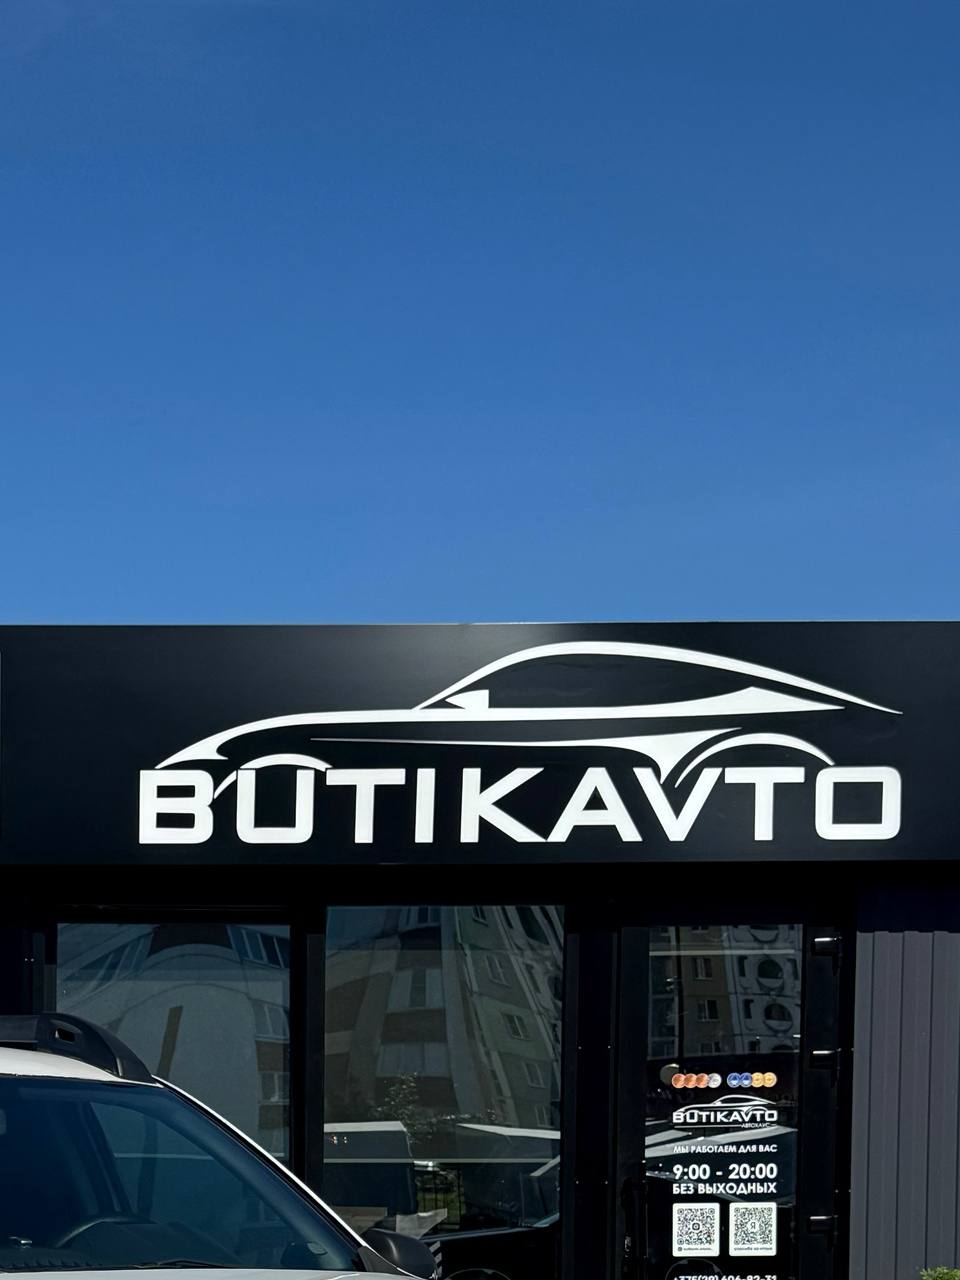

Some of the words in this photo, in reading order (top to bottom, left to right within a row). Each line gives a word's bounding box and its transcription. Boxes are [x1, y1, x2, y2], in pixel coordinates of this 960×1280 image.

[139, 765, 902, 845] BUTIKAVTO
[672, 1110, 778, 1123] BUTIKAVTO
[673, 1145, 689, 1154] МЫ
[691, 1145, 737, 1153] РАБОТАЕМ
[738, 1145, 757, 1153] ДЛЯ
[758, 1144, 778, 1152] ВАС
[672, 1164, 711, 1180] 9:00
[728, 1163, 778, 1179] 20:00
[672, 1183, 694, 1195] БЕЗ
[697, 1182, 777, 1195] ВЫХОДНЫХ
